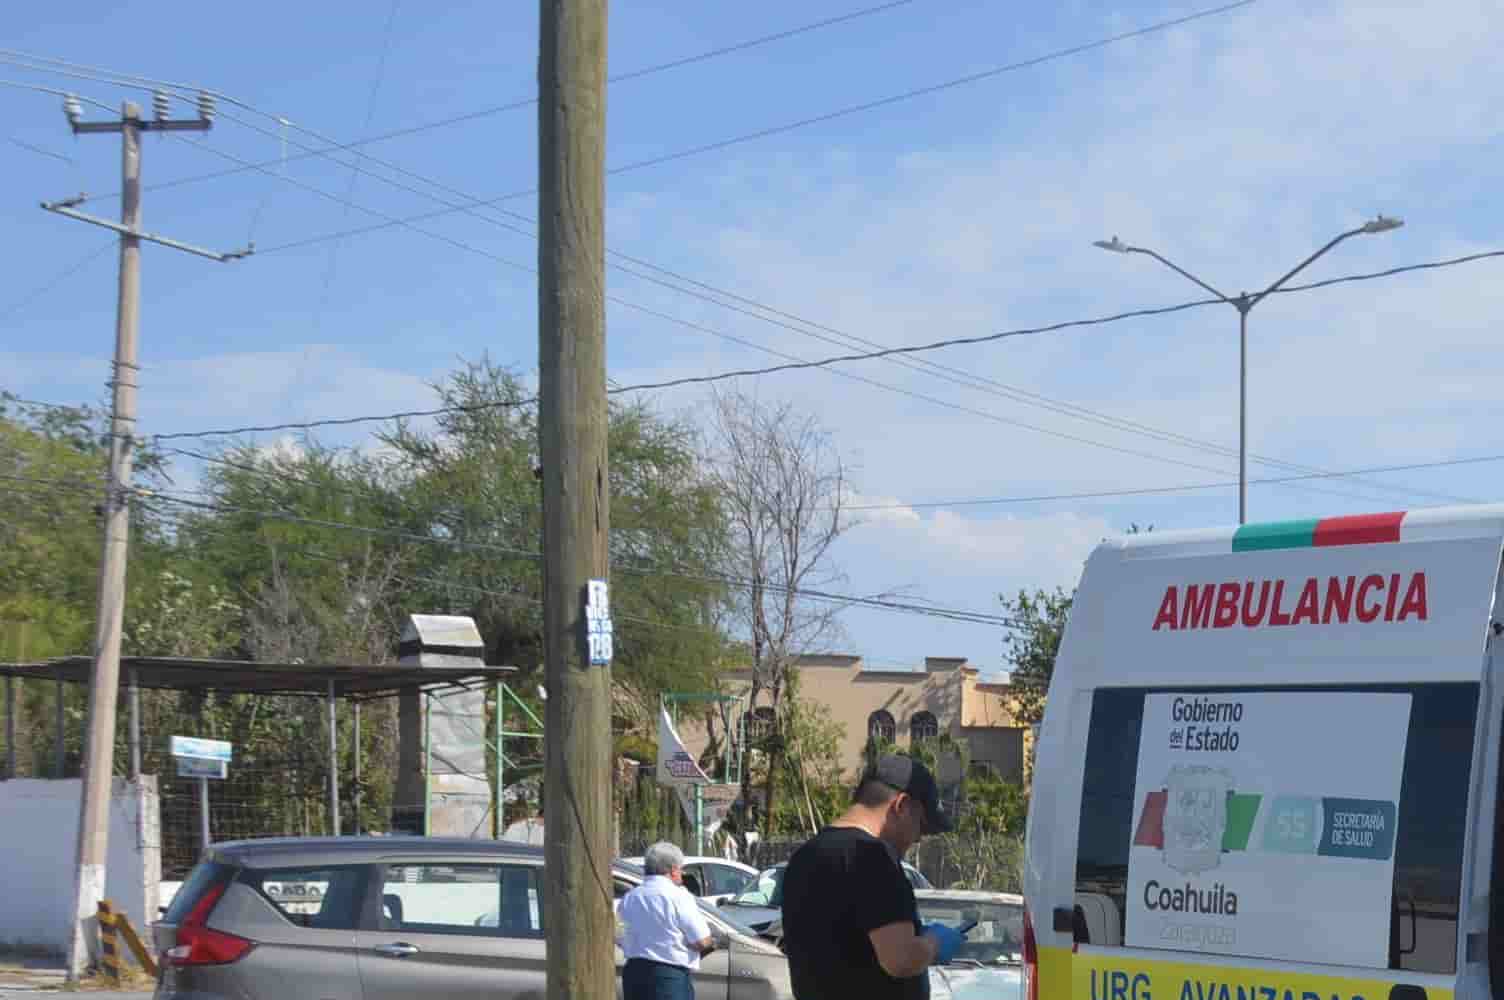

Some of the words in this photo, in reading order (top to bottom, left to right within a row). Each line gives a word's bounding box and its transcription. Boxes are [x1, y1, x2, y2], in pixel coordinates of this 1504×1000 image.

[1152, 571, 1428, 631] AMBULANCIA
[1171, 696, 1244, 722] Gobierno
[1169, 727, 1184, 744] del
[1185, 726, 1240, 751] Estado
[1331, 829, 1345, 846] DE
[1345, 830, 1375, 849] SALUD
[1143, 879, 1238, 915] Coahuila
